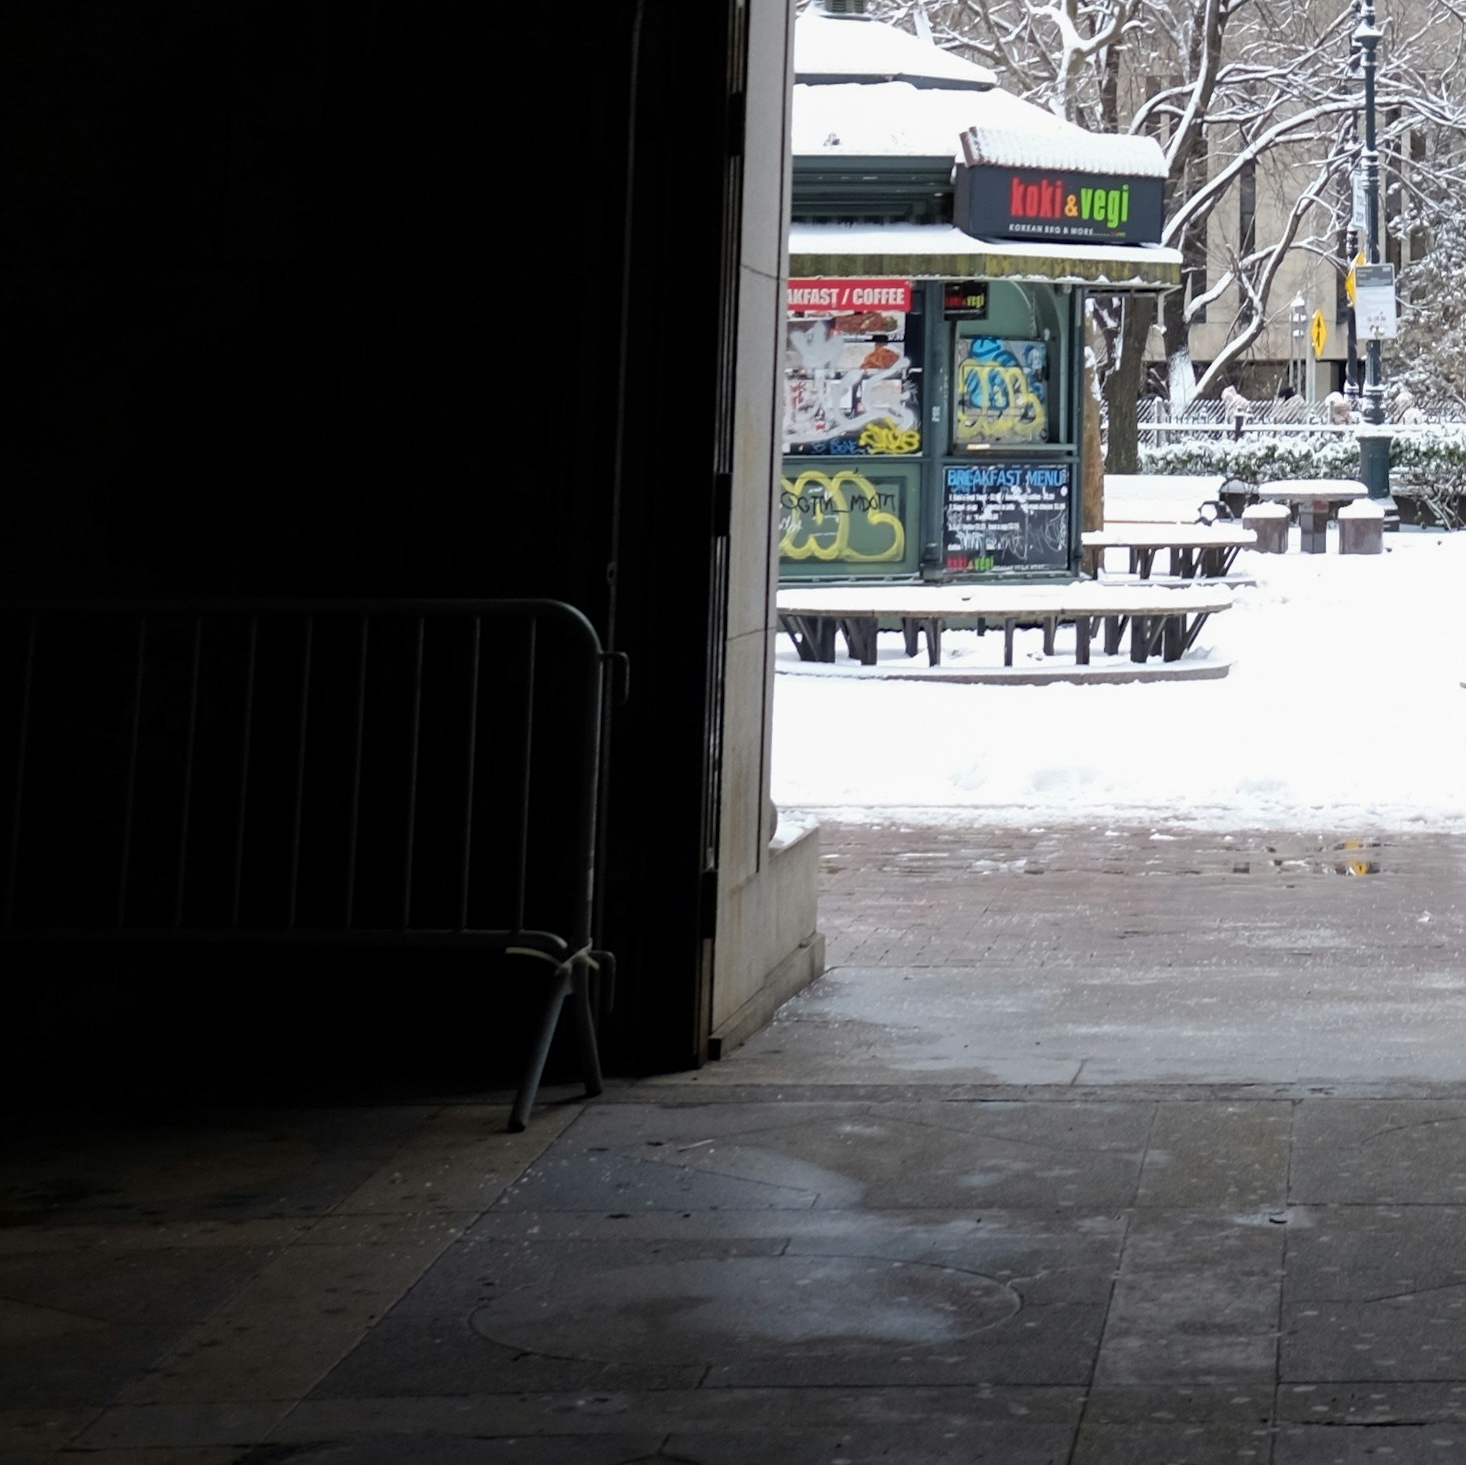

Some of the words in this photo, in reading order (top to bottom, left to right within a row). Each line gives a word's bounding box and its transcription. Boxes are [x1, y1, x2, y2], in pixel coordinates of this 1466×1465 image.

[1010, 177, 1063, 218] koki
[1064, 194, 1078, 217] &
[1080, 184, 1129, 228] vegi
[852, 288, 905, 305] COFFEE
[948, 469, 1022, 486] BREAKFAST
[1027, 470, 1063, 486] MENU
